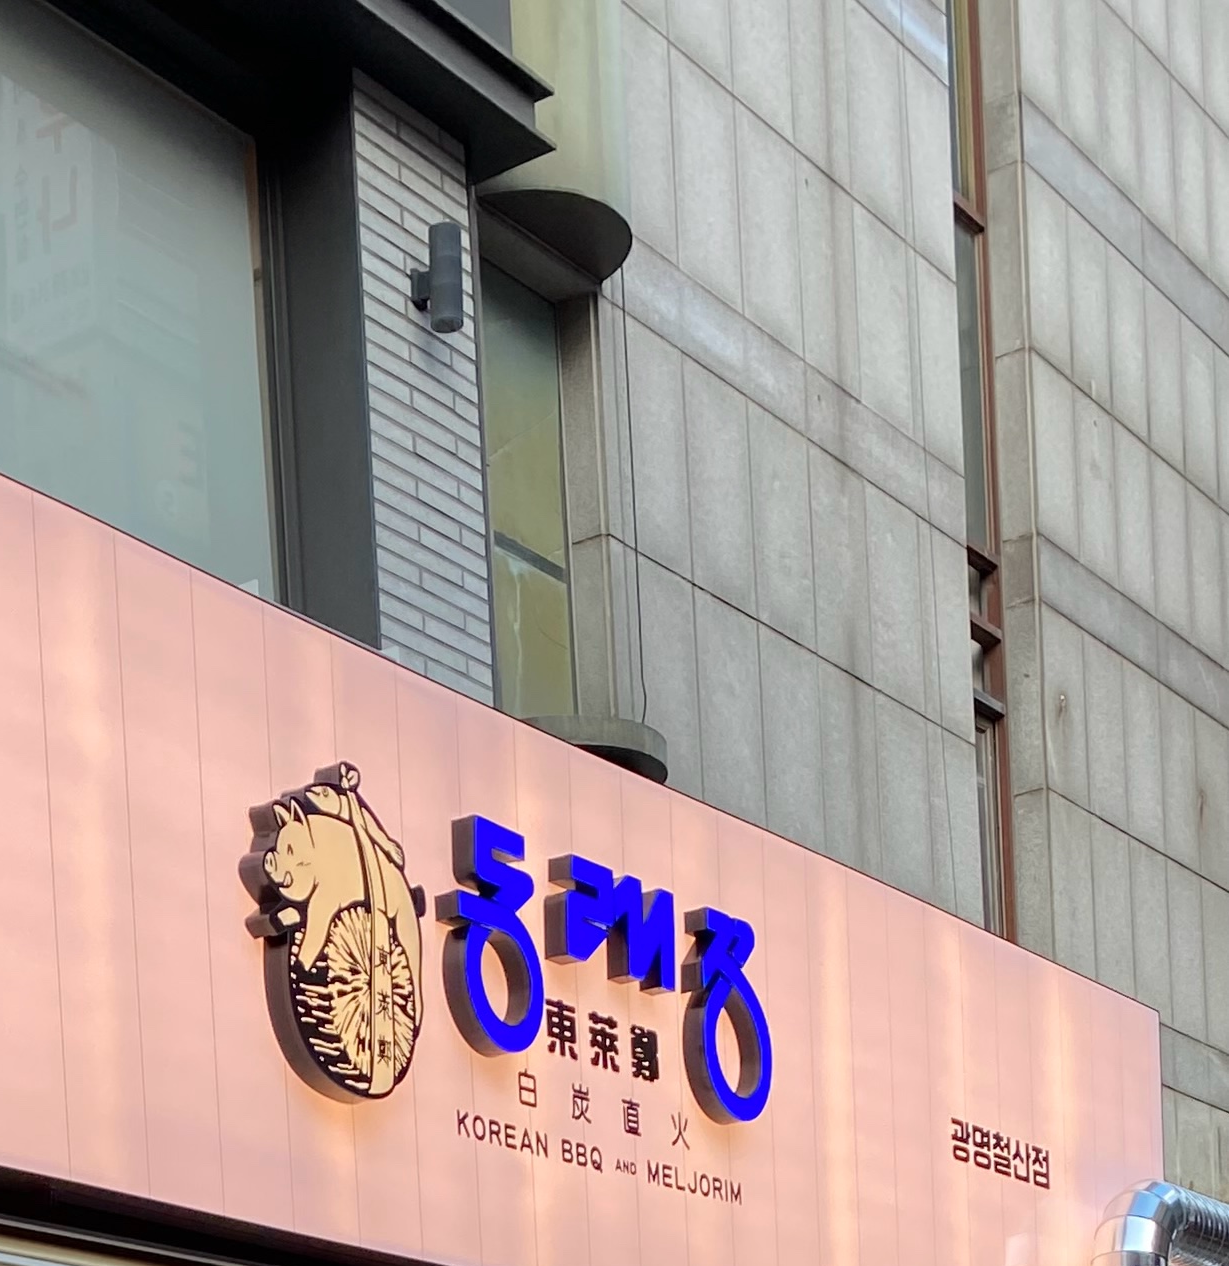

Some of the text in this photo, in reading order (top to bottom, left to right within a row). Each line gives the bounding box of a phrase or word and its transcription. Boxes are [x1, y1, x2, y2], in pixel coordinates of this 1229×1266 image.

[455, 1109, 743, 1206] KOREAN BBQ AND MELJORIM
[951, 1117, 1050, 1190] 광명철산점
